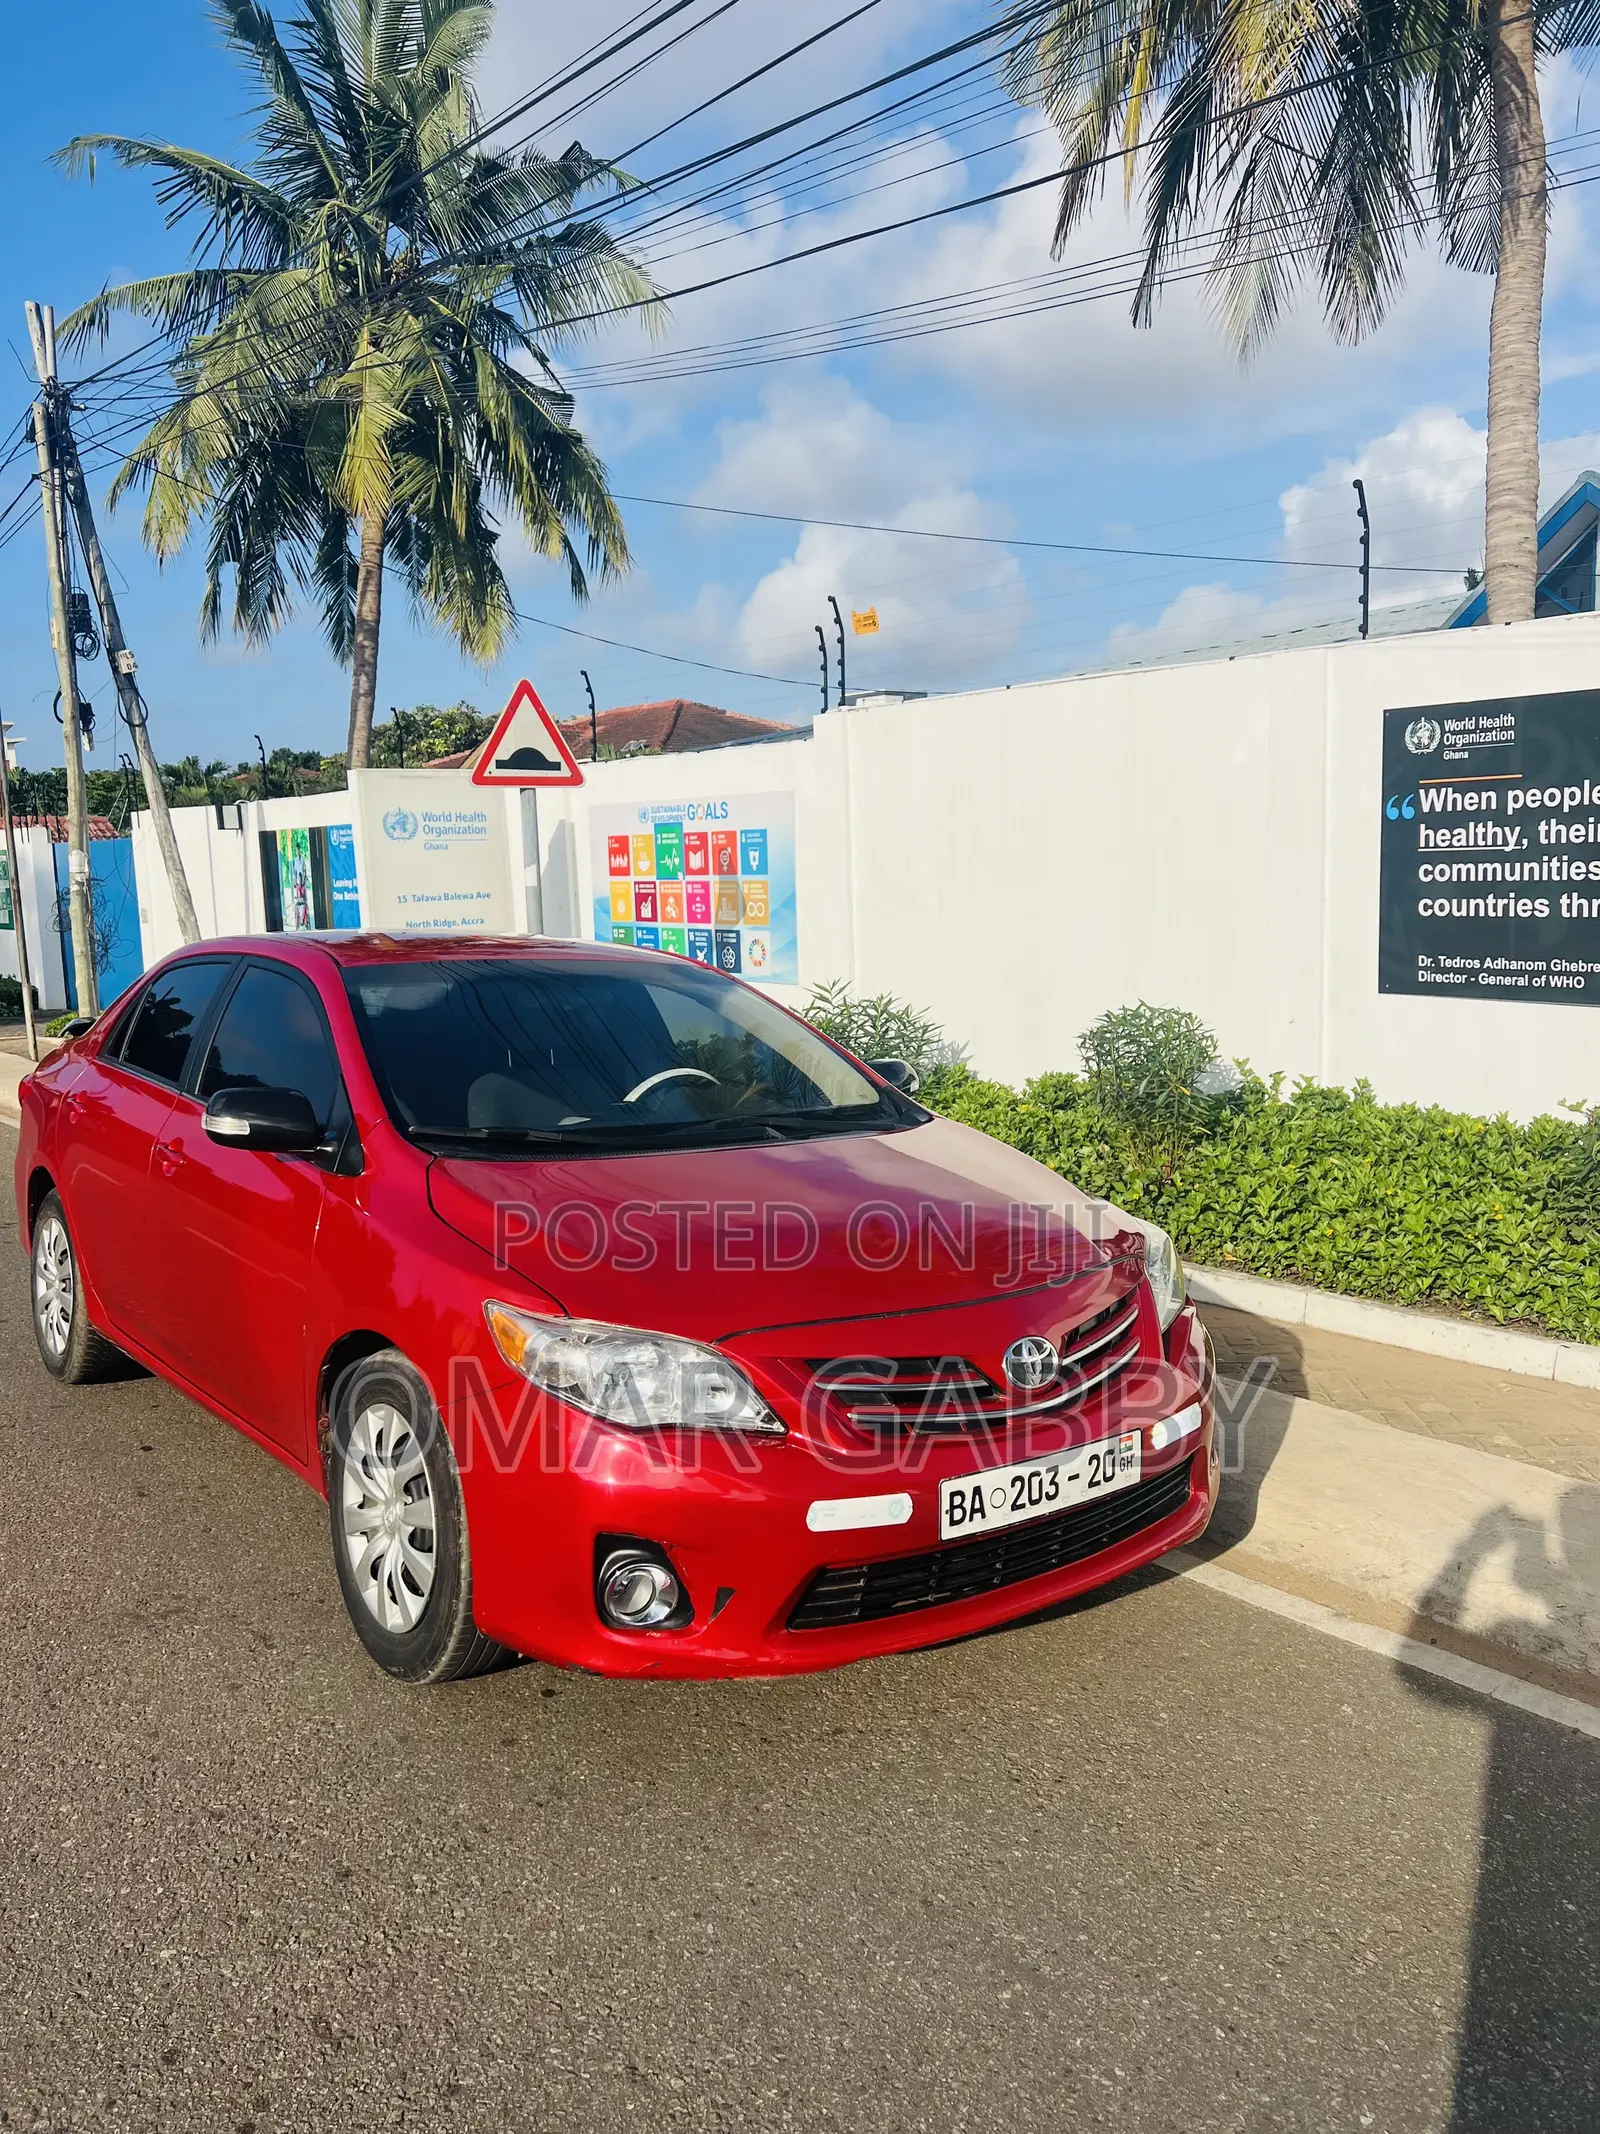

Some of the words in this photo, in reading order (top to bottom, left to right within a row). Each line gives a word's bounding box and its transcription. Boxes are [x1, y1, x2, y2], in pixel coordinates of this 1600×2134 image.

[1444, 716, 1476, 732] World
[1479, 713, 1515, 729] Health
[1443, 728, 1515, 747] Organization
[1443, 751, 1469, 760] Ghana
[651, 804, 687, 814] SUSTAINABLE
[1419, 787, 1497, 813] When
[422, 811, 452, 823] World
[455, 811, 487, 823] Health
[651, 813, 687, 823] DEVELOPMENT
[687, 801, 729, 821] GOALS
[422, 824, 487, 838] Organization
[1418, 820, 1529, 853] healthy,
[423, 842, 449, 851] Ghana
[1418, 855, 1600, 882] communities
[397, 895, 408, 904] 15
[412, 894, 442, 903] Tafawa
[444, 892, 474, 901] Balewa
[475, 891, 491, 900] Ave
[1418, 892, 1550, 918] countries
[406, 919, 431, 928] North
[461, 917, 484, 926] Accra
[1418, 955, 1436, 967] Dr.
[1438, 955, 1481, 969] Tedros
[1483, 957, 1547, 971] Adhanom
[1550, 959, 1600, 973] Ghebre
[1418, 971, 1467, 984] Director
[1478, 972, 1529, 987] General
[1532, 974, 1546, 987] of
[1549, 975, 1585, 989] WHO
[1119, 1454, 1134, 1473] GH
[949, 1485, 987, 1527] BA
[1010, 1465, 1060, 1512] 203
[1088, 1448, 1116, 1489] 20
